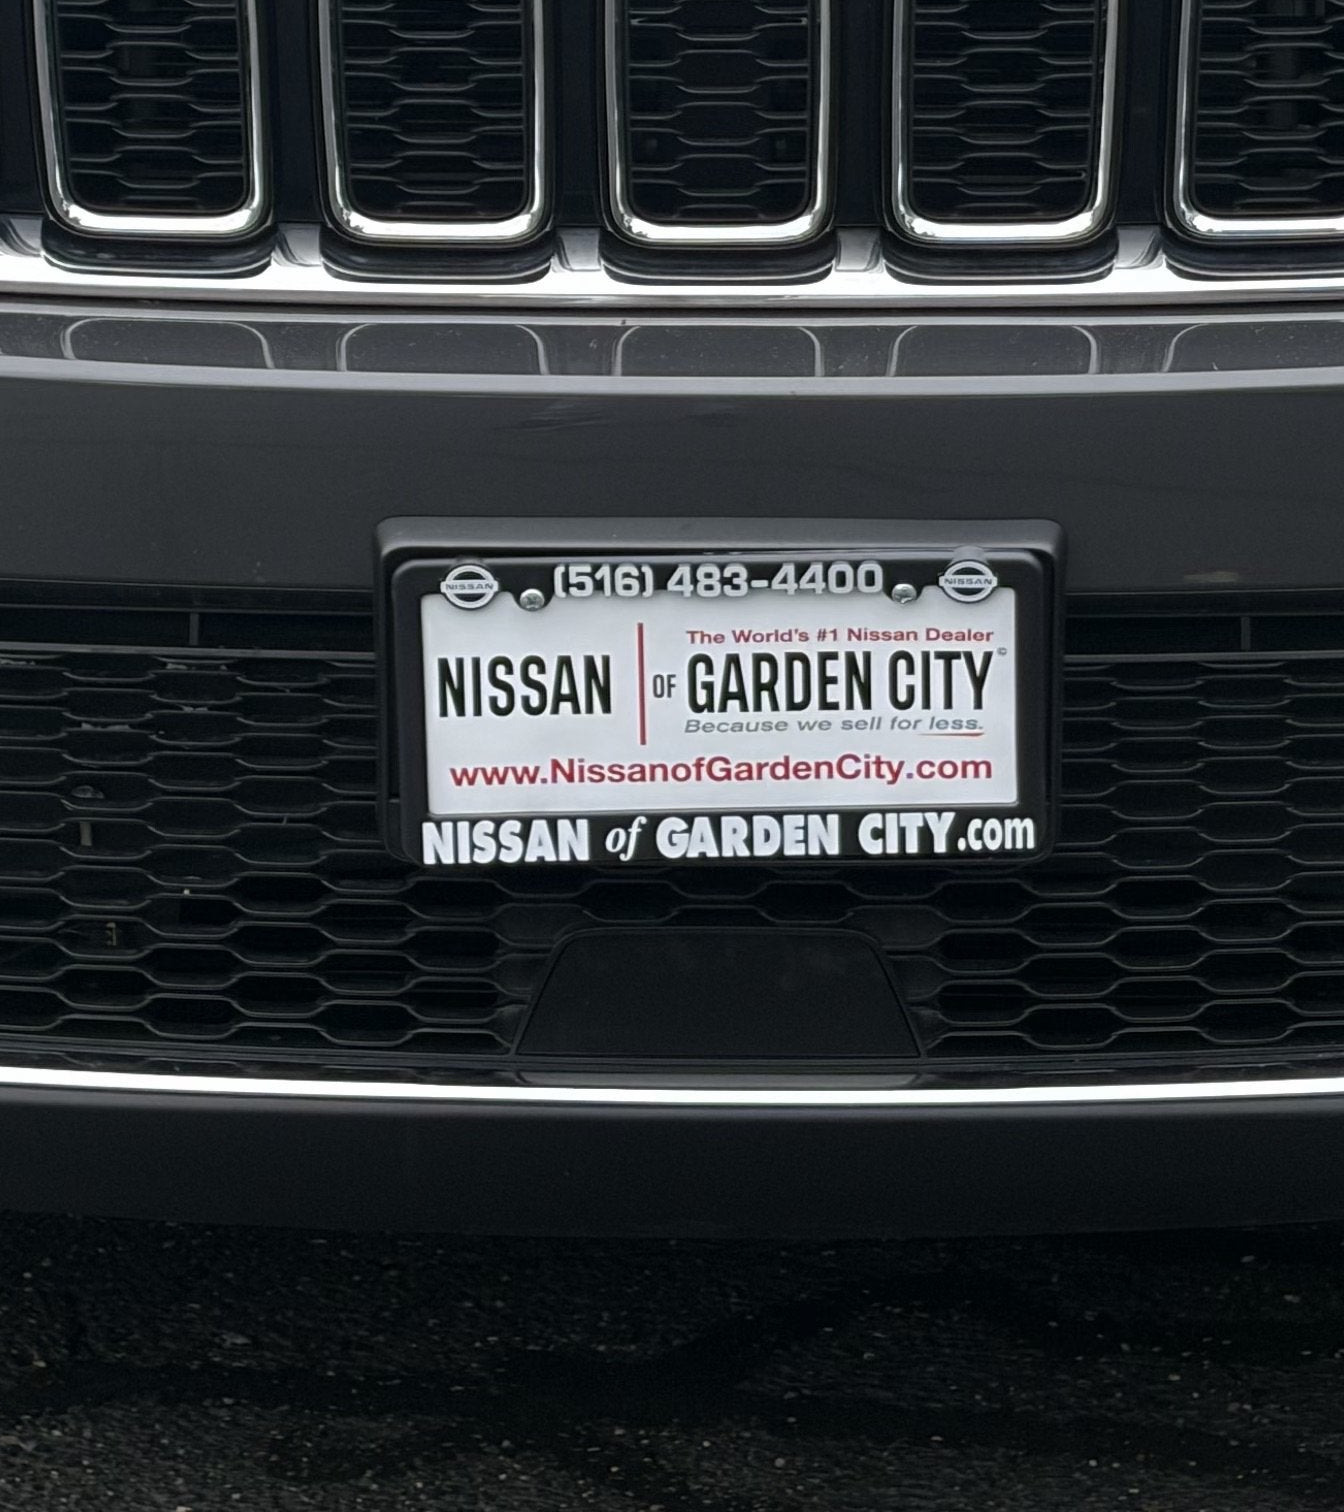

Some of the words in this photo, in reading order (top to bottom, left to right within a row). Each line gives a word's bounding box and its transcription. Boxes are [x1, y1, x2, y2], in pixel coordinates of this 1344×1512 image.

[445, 582, 495, 591] NISSAN
[554, 564, 654, 598] (516)
[667, 561, 884, 597] 483-4400
[944, 577, 993, 586] NISSAN
[686, 630, 725, 644] The
[732, 628, 809, 643] World's
[817, 628, 838, 642] #1
[847, 628, 918, 642] Nissan
[925, 627, 994, 642] Dealer
[437, 655, 611, 717] NISSAN
[652, 674, 676, 699] OF
[687, 650, 872, 714] GARDEN
[888, 649, 993, 711] CITY
[684, 718, 789, 734] Because
[798, 719, 832, 731] we
[841, 716, 882, 731] sell
[890, 716, 922, 730] for
[929, 716, 984, 730] less.
[450, 753, 993, 786] www.NissanofGardenCity.com
[422, 818, 590, 865] NISSAN
[605, 816, 647, 862] of
[656, 814, 840, 859] GARDEN
[858, 812, 1035, 856] CITY.com
